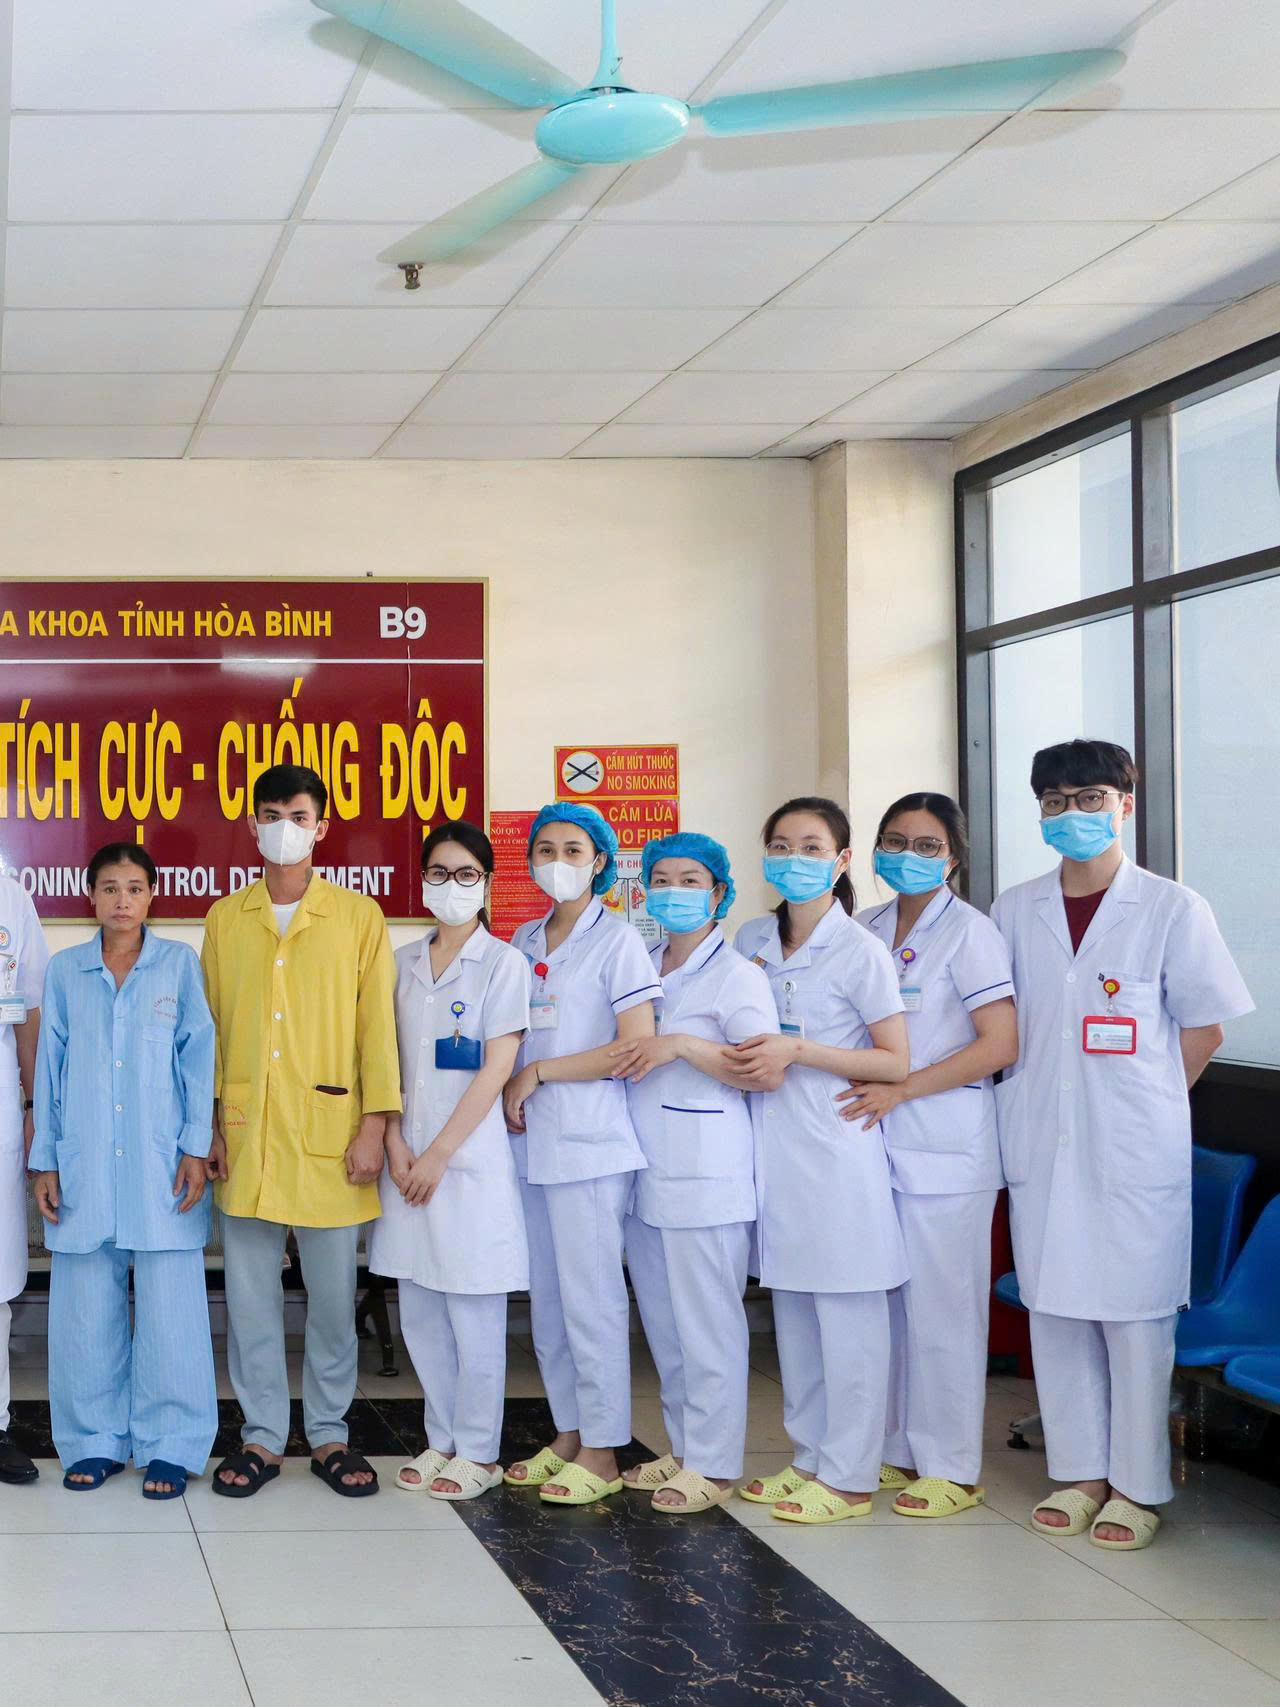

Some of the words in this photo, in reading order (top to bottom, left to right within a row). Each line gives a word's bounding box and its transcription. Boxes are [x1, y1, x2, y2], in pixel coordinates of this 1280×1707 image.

[28, 610, 109, 637] KHOA
[118, 601, 184, 637] TỈNH
[194, 602, 256, 637] HÒA
[265, 602, 332, 637] BÌNH
[379, 606, 427, 640] B9
[99, 708, 182, 845] CỰC
[218, 677, 360, 820] CHỐNG
[380, 698, 467, 842] ĐỘC
[606, 750, 624, 770] CẤM
[627, 751, 643, 770] HÚT
[646, 749, 674, 769] THUỐC
[607, 775, 623, 790] NO
[625, 774, 675, 790] SMOKING
[609, 801, 640, 822] CẤM
[645, 801, 674, 822] LỬA
[618, 828, 634, 844] O
